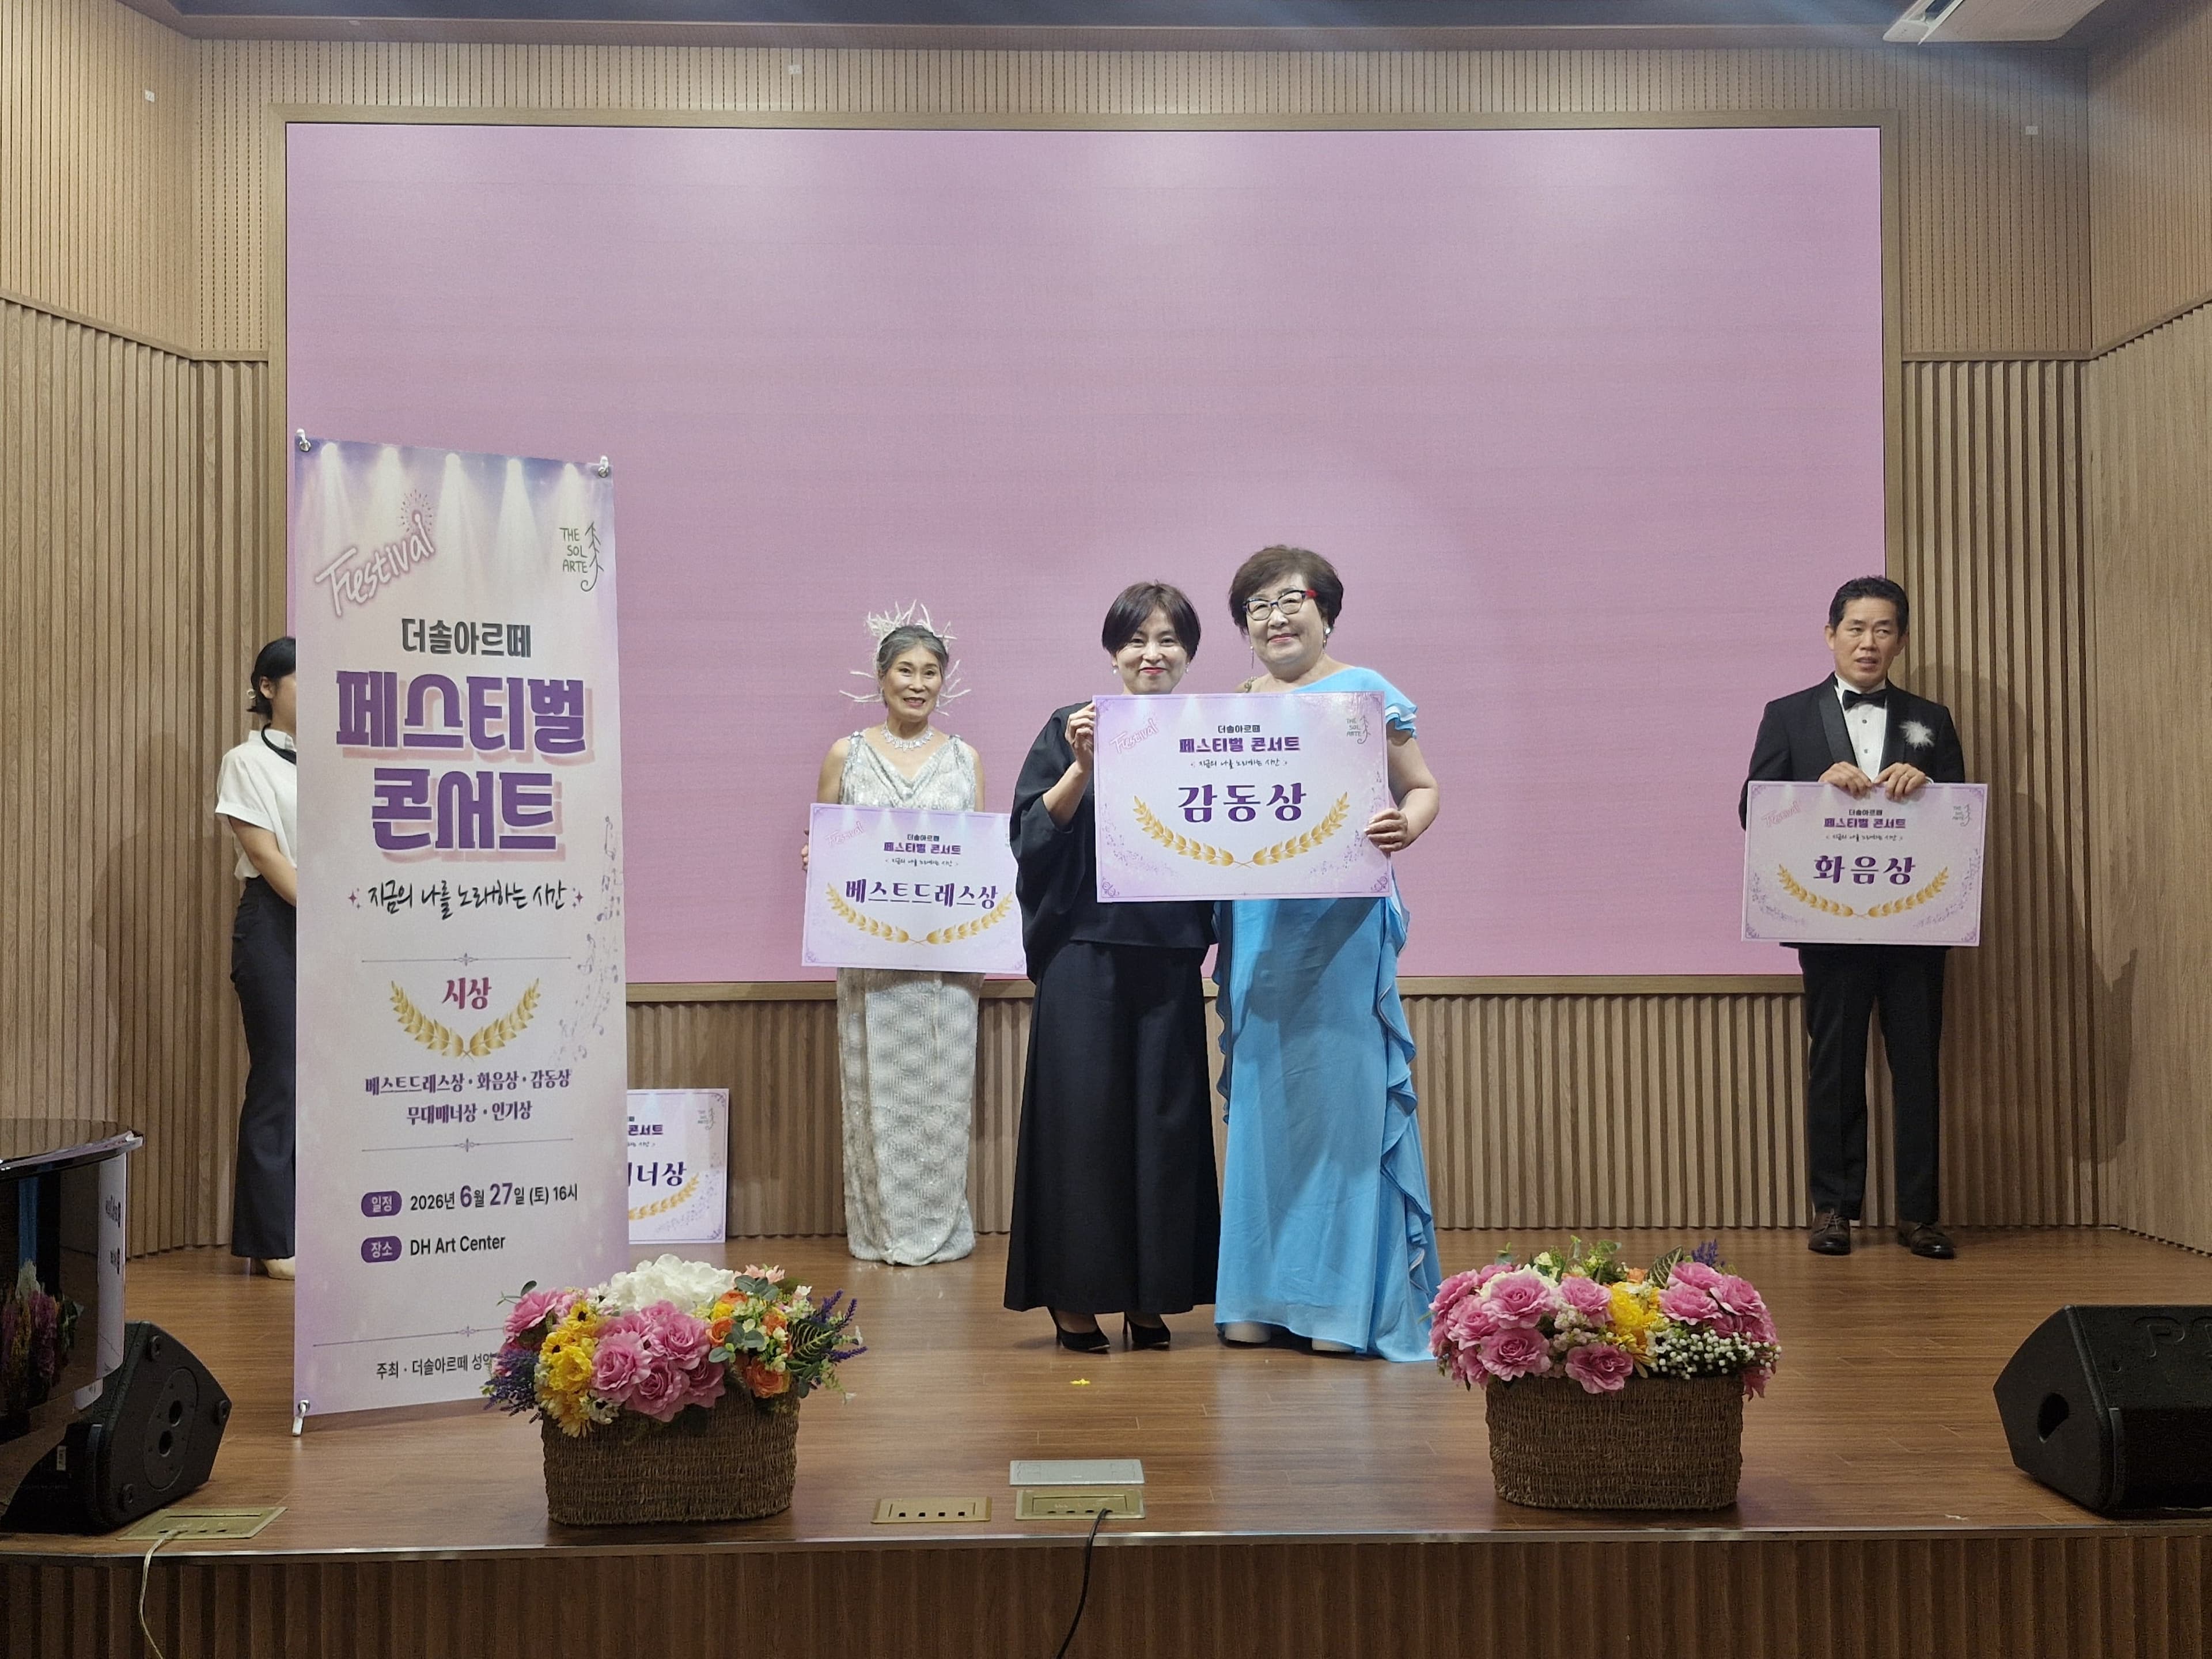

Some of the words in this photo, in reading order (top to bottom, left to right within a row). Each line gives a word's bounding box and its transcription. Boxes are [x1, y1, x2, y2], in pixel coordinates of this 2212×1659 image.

[561, 528, 580, 541] THE
[567, 546, 587, 558] SOL
[562, 561, 589, 574] ARTE
[402, 618, 531, 657] 더솔아르떼
[336, 671, 586, 754] 페스티벌
[1179, 737, 1244, 753] 페스티벌
[1251, 737, 1301, 752] 콘서트
[372, 767, 558, 851] 콘서트
[1177, 782, 1307, 823] 감동상
[1824, 818, 1868, 828] 페스티벌
[1873, 818, 1906, 828] 콘서트
[884, 842, 926, 854] 페스티벌
[930, 843, 961, 855] 콘서트
[1813, 855, 1916, 885] 화음상
[368, 879, 413, 914] 지금의
[421, 880, 453, 920] 나를
[458, 880, 528, 909] 노래하는
[532, 879, 567, 910] 시간
[846, 878, 998, 910] 베스트드레스상
[442, 976, 491, 1009] 시상
[365, 1072, 464, 1096] 베스트드레스상
[476, 1070, 518, 1090] 화음상
[531, 1068, 571, 1089] 감동상
[407, 1103, 478, 1125] 무대매너상
[491, 1100, 533, 1121] 인기상
[628, 1124, 664, 1136] 콘서트
[628, 1162, 687, 1187] 너상
[370, 1195, 393, 1213] 일정
[410, 1191, 455, 1210] 2026년
[460, 1184, 484, 1208] 6월
[490, 1182, 525, 1206] 27일
[529, 1186, 549, 1206] (토)
[553, 1183, 578, 1201] 16시
[370, 1240, 393, 1258] 장소
[410, 1238, 431, 1256] DH
[435, 1237, 456, 1254] Art
[460, 1234, 506, 1252] Center
[376, 1360, 399, 1380] 주최
[412, 1354, 468, 1377] 더솔아르떼
